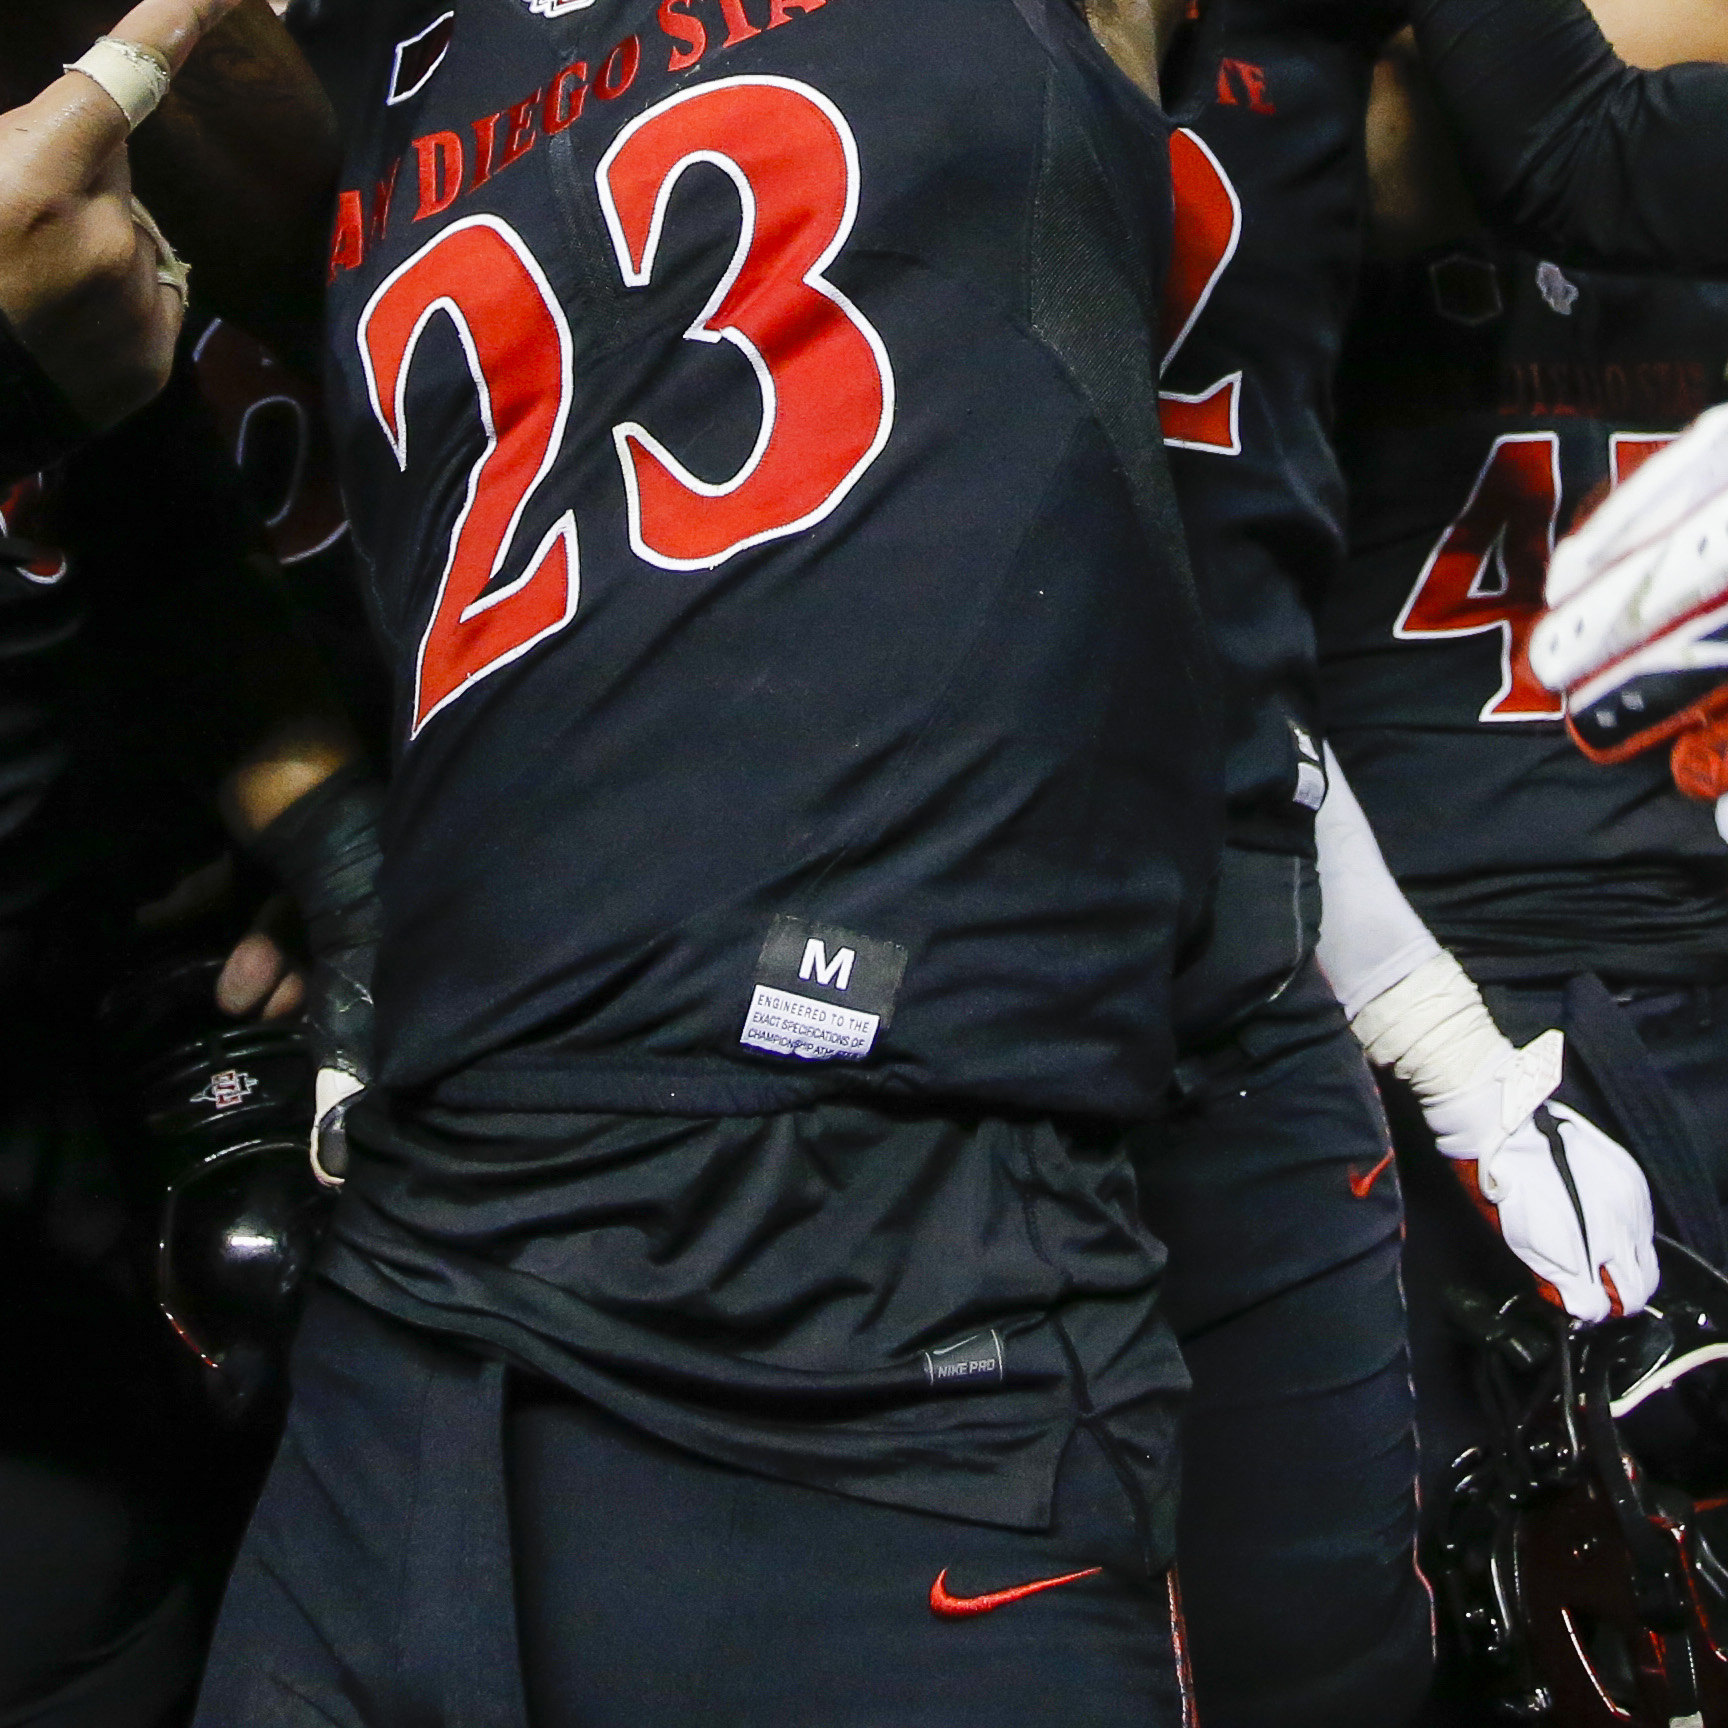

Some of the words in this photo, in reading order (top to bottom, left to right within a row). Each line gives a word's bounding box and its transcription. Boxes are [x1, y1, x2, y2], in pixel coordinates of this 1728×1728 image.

[328, 156, 400, 286] AN
[413, 33, 642, 222] DIEGO
[356, 74, 897, 742] 23
[798, 938, 857, 991] M
[752, 1011, 781, 1028] EXACT
[781, 1019, 850, 1047] SPECIFICATIONS
[850, 1037, 866, 1050] OF
[757, 994, 827, 1022] ENGINEERED
[831, 1013, 845, 1027] TO
[849, 1018, 870, 1033] THE
[747, 1027, 815, 1052] CHAMPIONSHIP
[937, 1361, 969, 1379] NIKE
[969, 1357, 996, 1375] PRO
